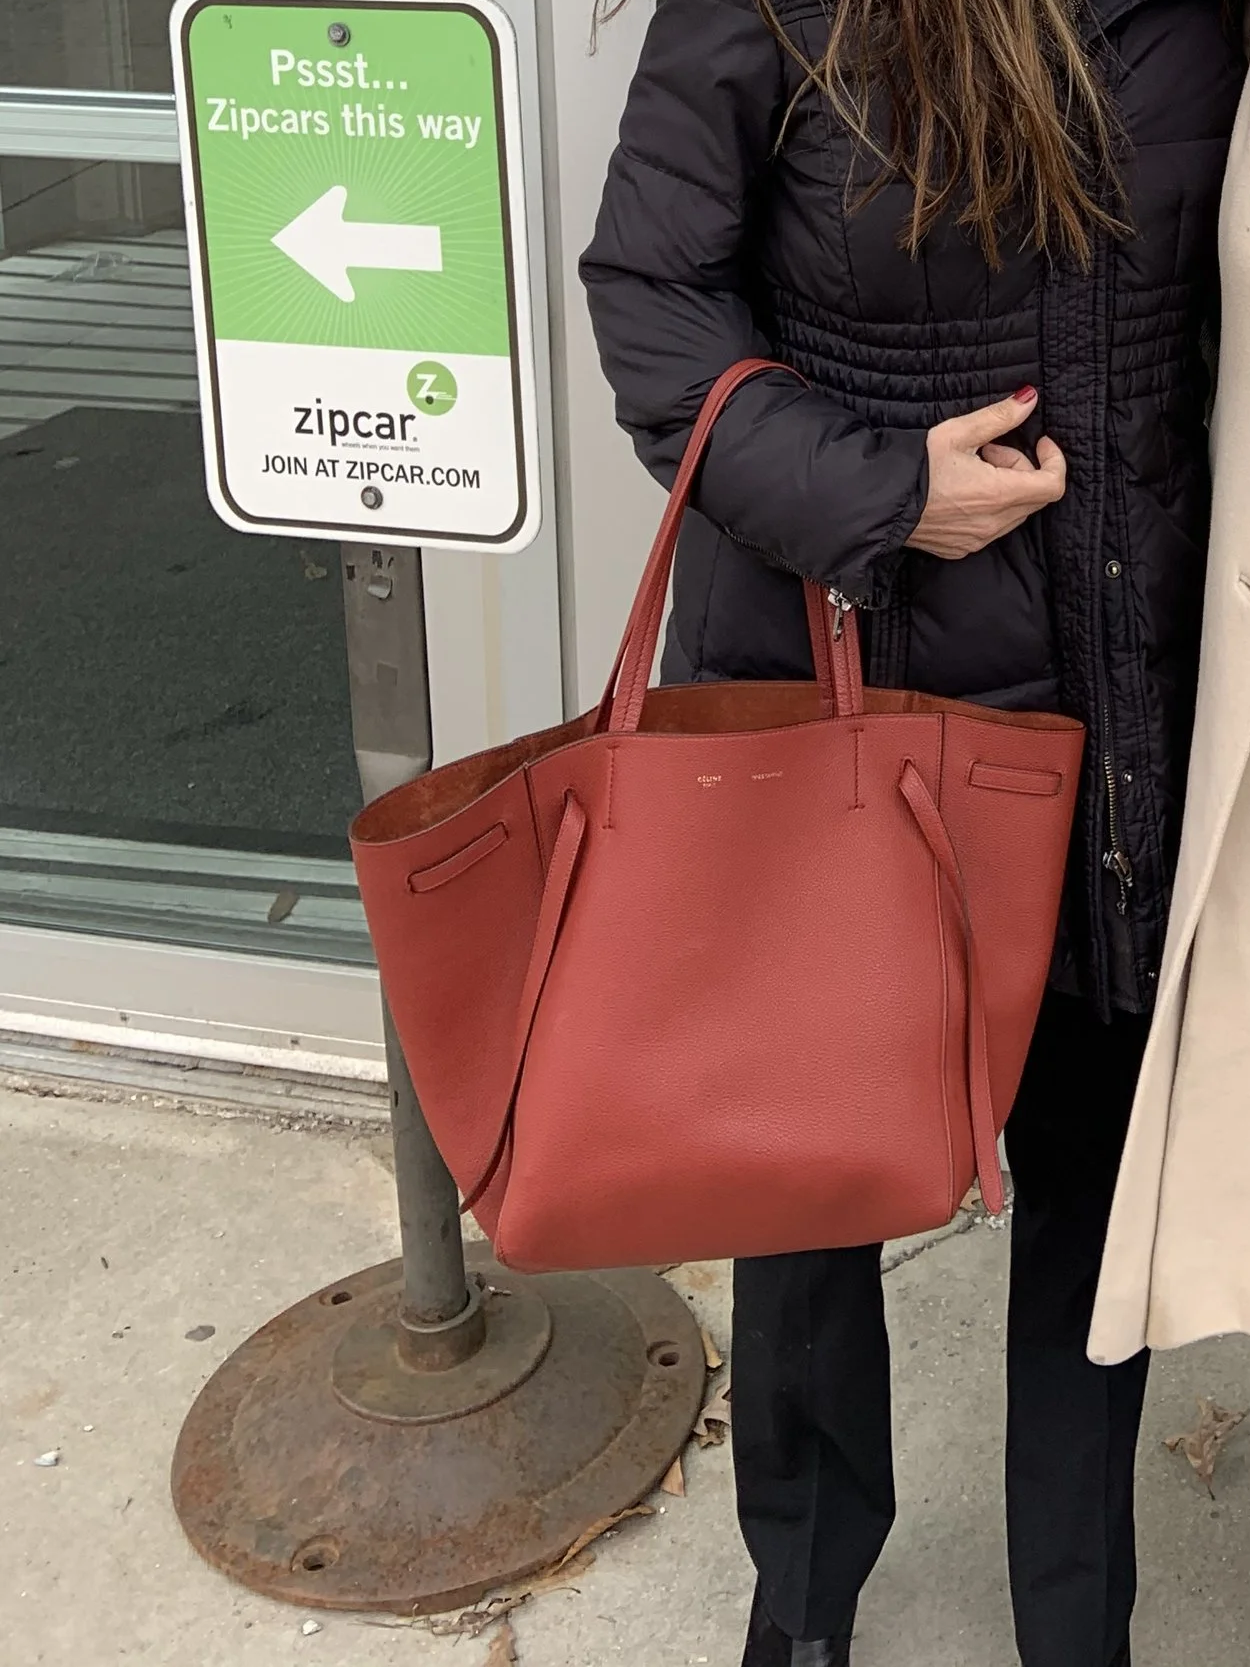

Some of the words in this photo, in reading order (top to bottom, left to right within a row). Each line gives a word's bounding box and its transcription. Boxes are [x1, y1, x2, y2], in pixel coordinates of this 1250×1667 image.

[270, 48, 408, 90] Pssst...
[206, 97, 330, 140] Zipcars
[341, 103, 405, 139] this
[417, 113, 482, 149] way
[262, 454, 308, 476] JOIN
[315, 458, 340, 478] AT
[346, 460, 481, 490] ZIPCAR.COM
